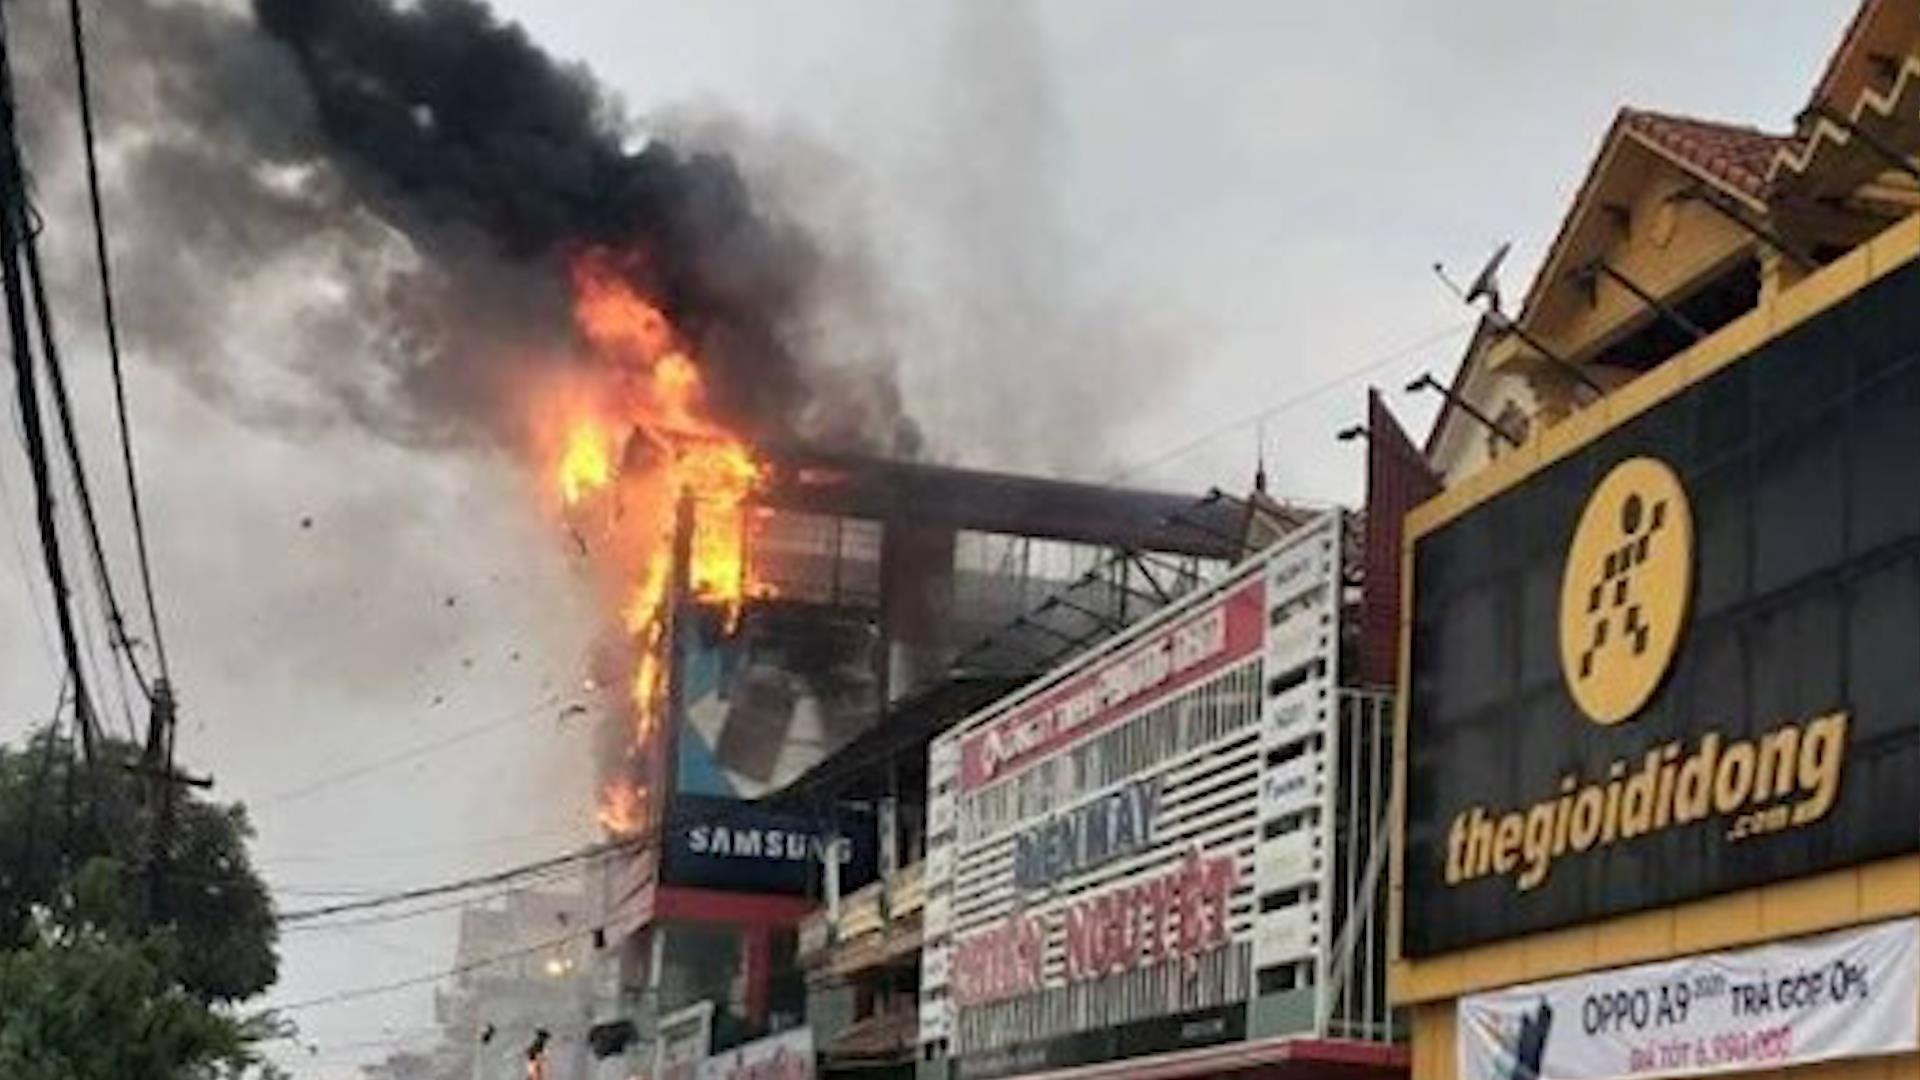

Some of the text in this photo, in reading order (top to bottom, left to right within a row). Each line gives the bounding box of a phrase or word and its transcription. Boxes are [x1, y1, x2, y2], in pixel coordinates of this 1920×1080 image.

[1444, 711, 1850, 891] thegioididong
[1727, 810, 1789, 841] .com
[688, 826, 851, 864] SAMSUNG
[1582, 988, 1650, 1035] OPPO
[1657, 983, 1690, 1026] A9
[1829, 961, 1869, 1001] 0%
